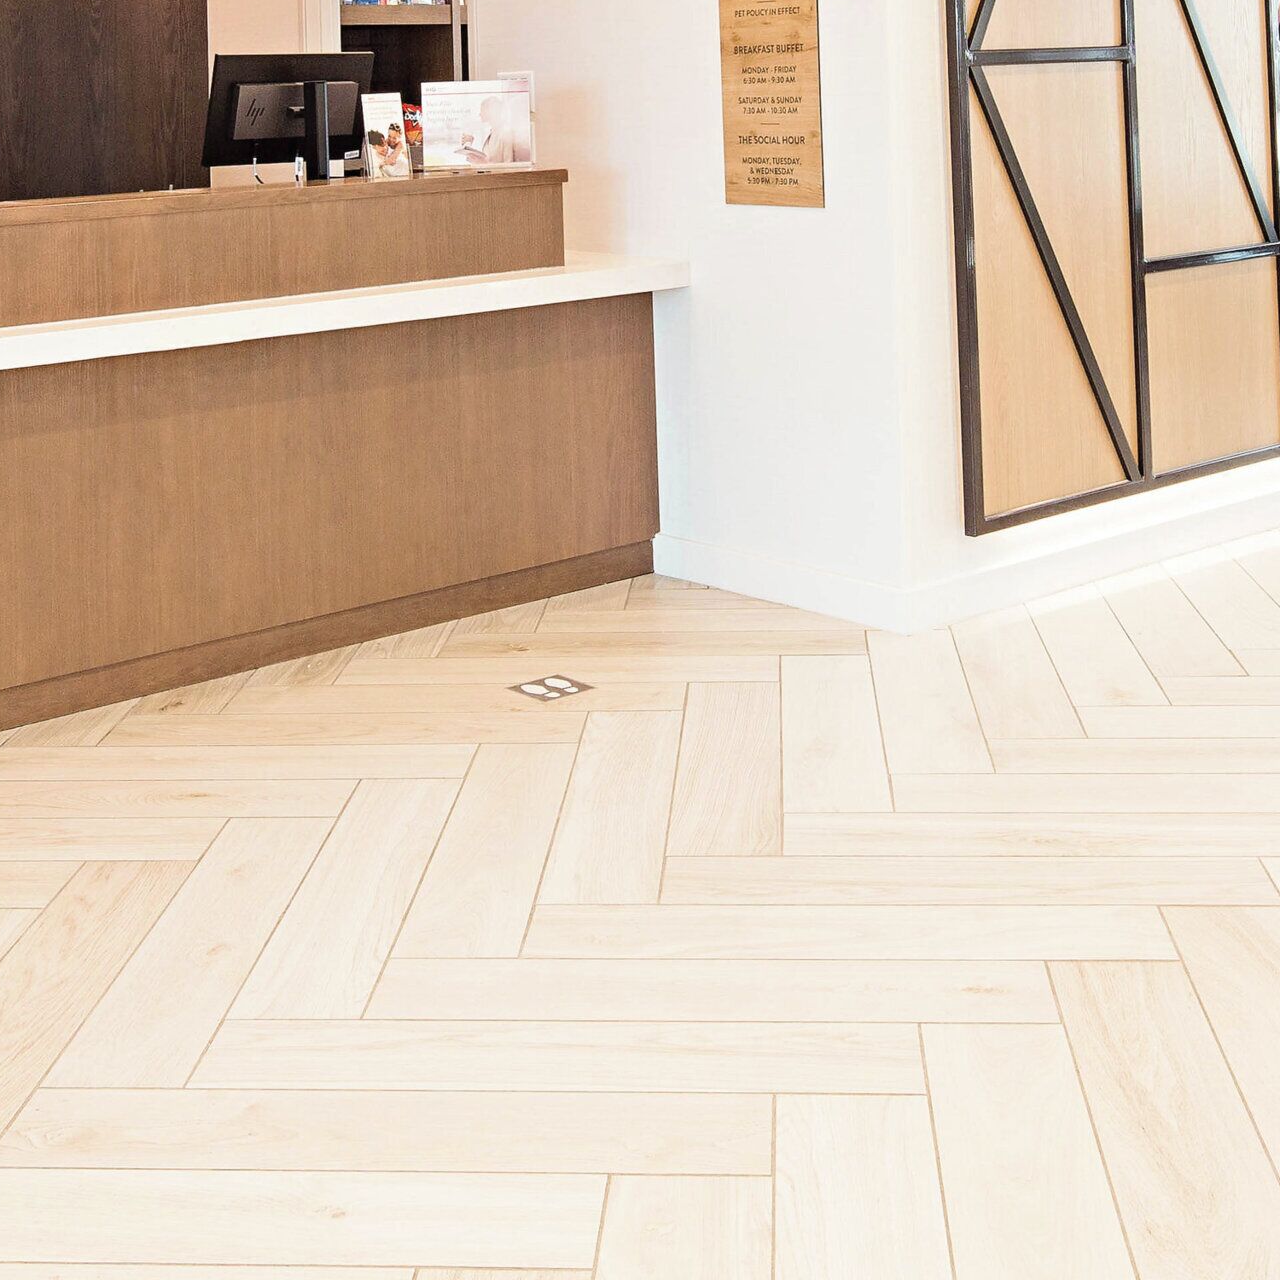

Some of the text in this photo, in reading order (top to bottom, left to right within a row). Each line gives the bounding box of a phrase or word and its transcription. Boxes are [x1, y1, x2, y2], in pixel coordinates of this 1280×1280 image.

[747, 8, 768, 17] POLICY
[734, 44, 804, 54] BREAKFAST BUFFET
[246, 99, 264, 126] hp
[739, 136, 806, 144] THE SOCIAL HOUR
